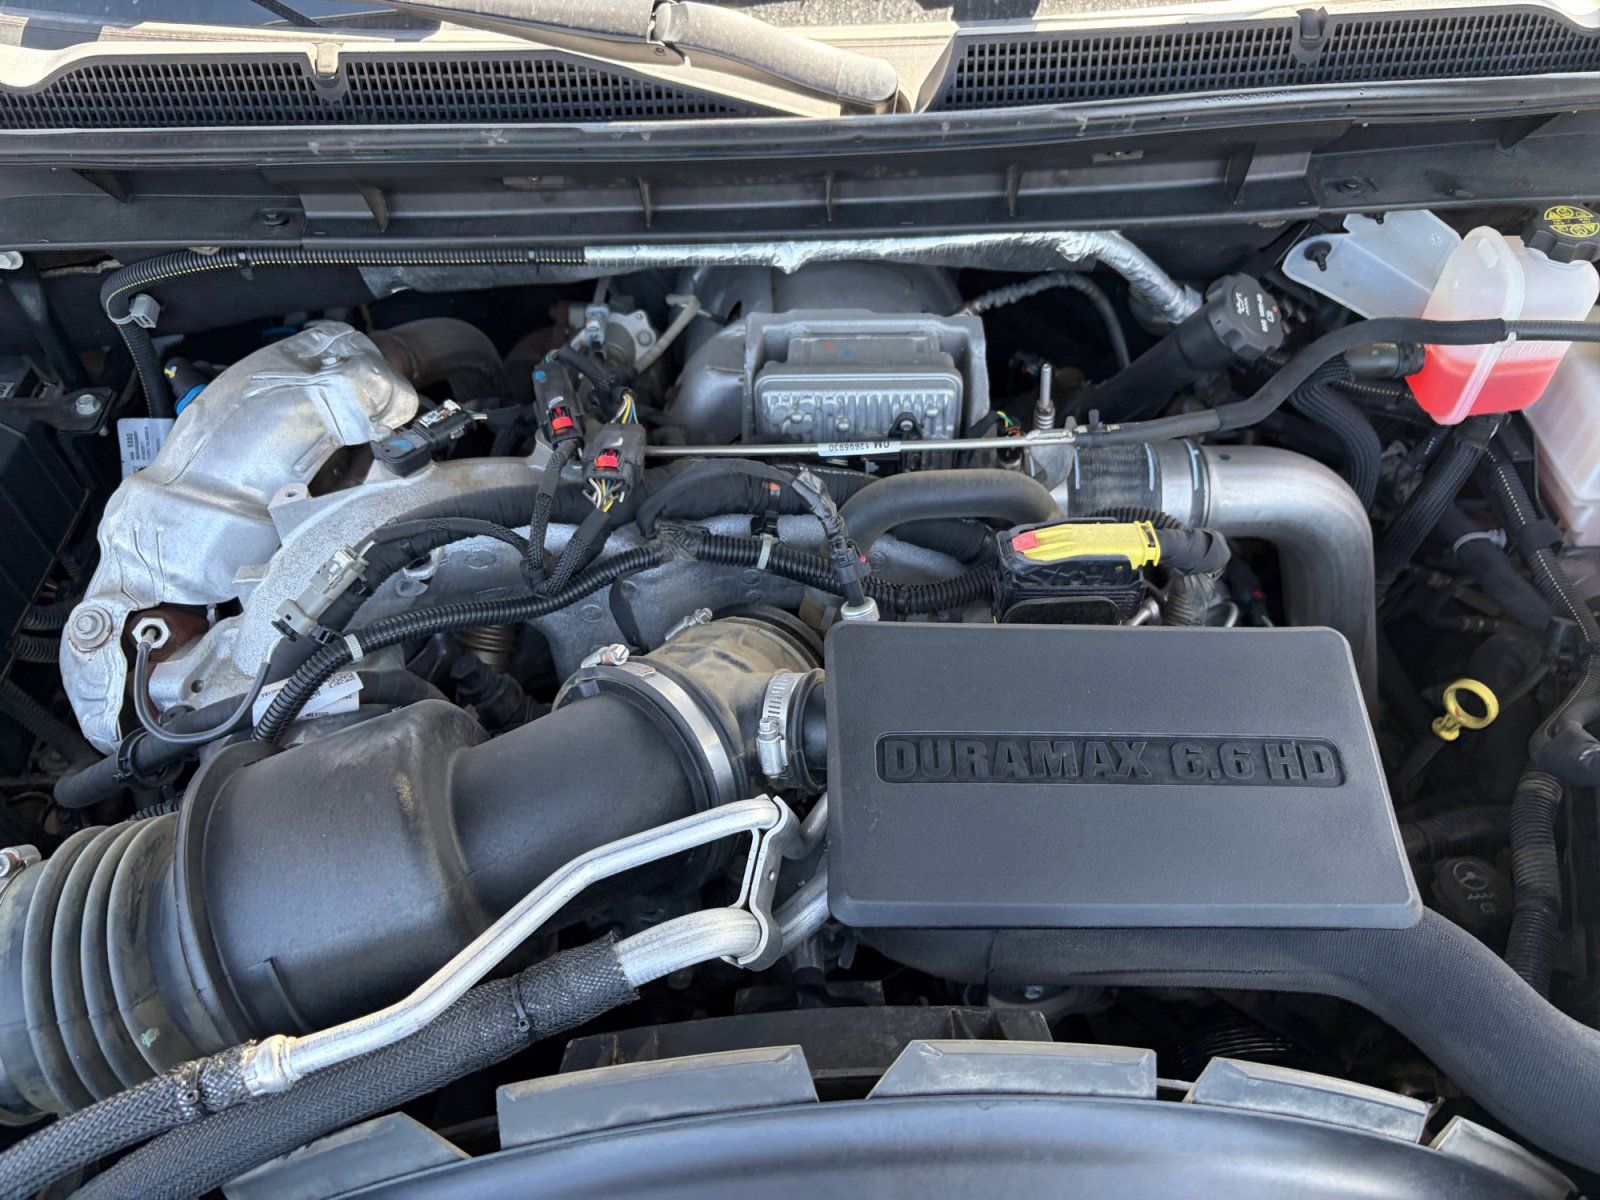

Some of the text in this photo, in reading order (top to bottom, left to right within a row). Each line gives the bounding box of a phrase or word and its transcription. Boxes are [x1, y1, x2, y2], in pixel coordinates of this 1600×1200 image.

[828, 442, 870, 452] 12695930
[883, 739, 1337, 781] DURAMAX 6.6 HD
